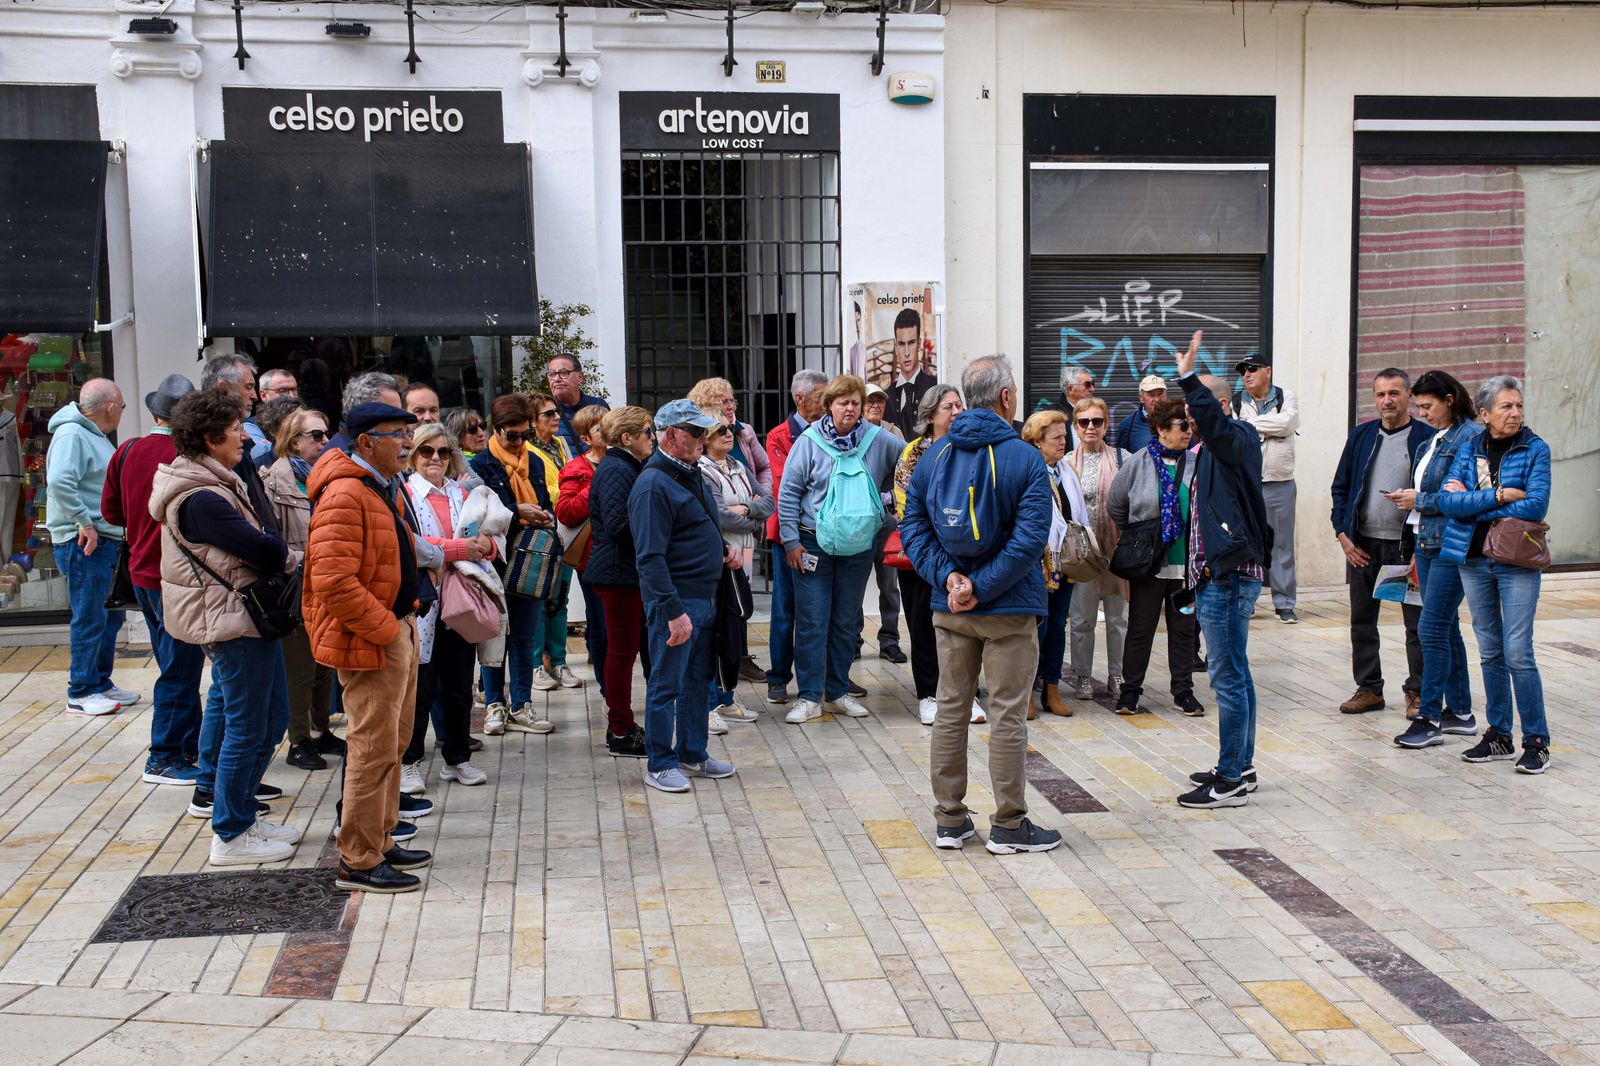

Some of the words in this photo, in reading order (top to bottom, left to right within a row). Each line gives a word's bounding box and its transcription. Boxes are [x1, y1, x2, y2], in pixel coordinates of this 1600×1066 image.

[268, 92, 356, 132] celso
[363, 95, 464, 143] prieto
[658, 97, 809, 135] artenovia
[702, 139, 729, 149] LOW
[732, 139, 764, 149] COST
[877, 293, 899, 305] celso
[901, 293, 925, 307] prieto
